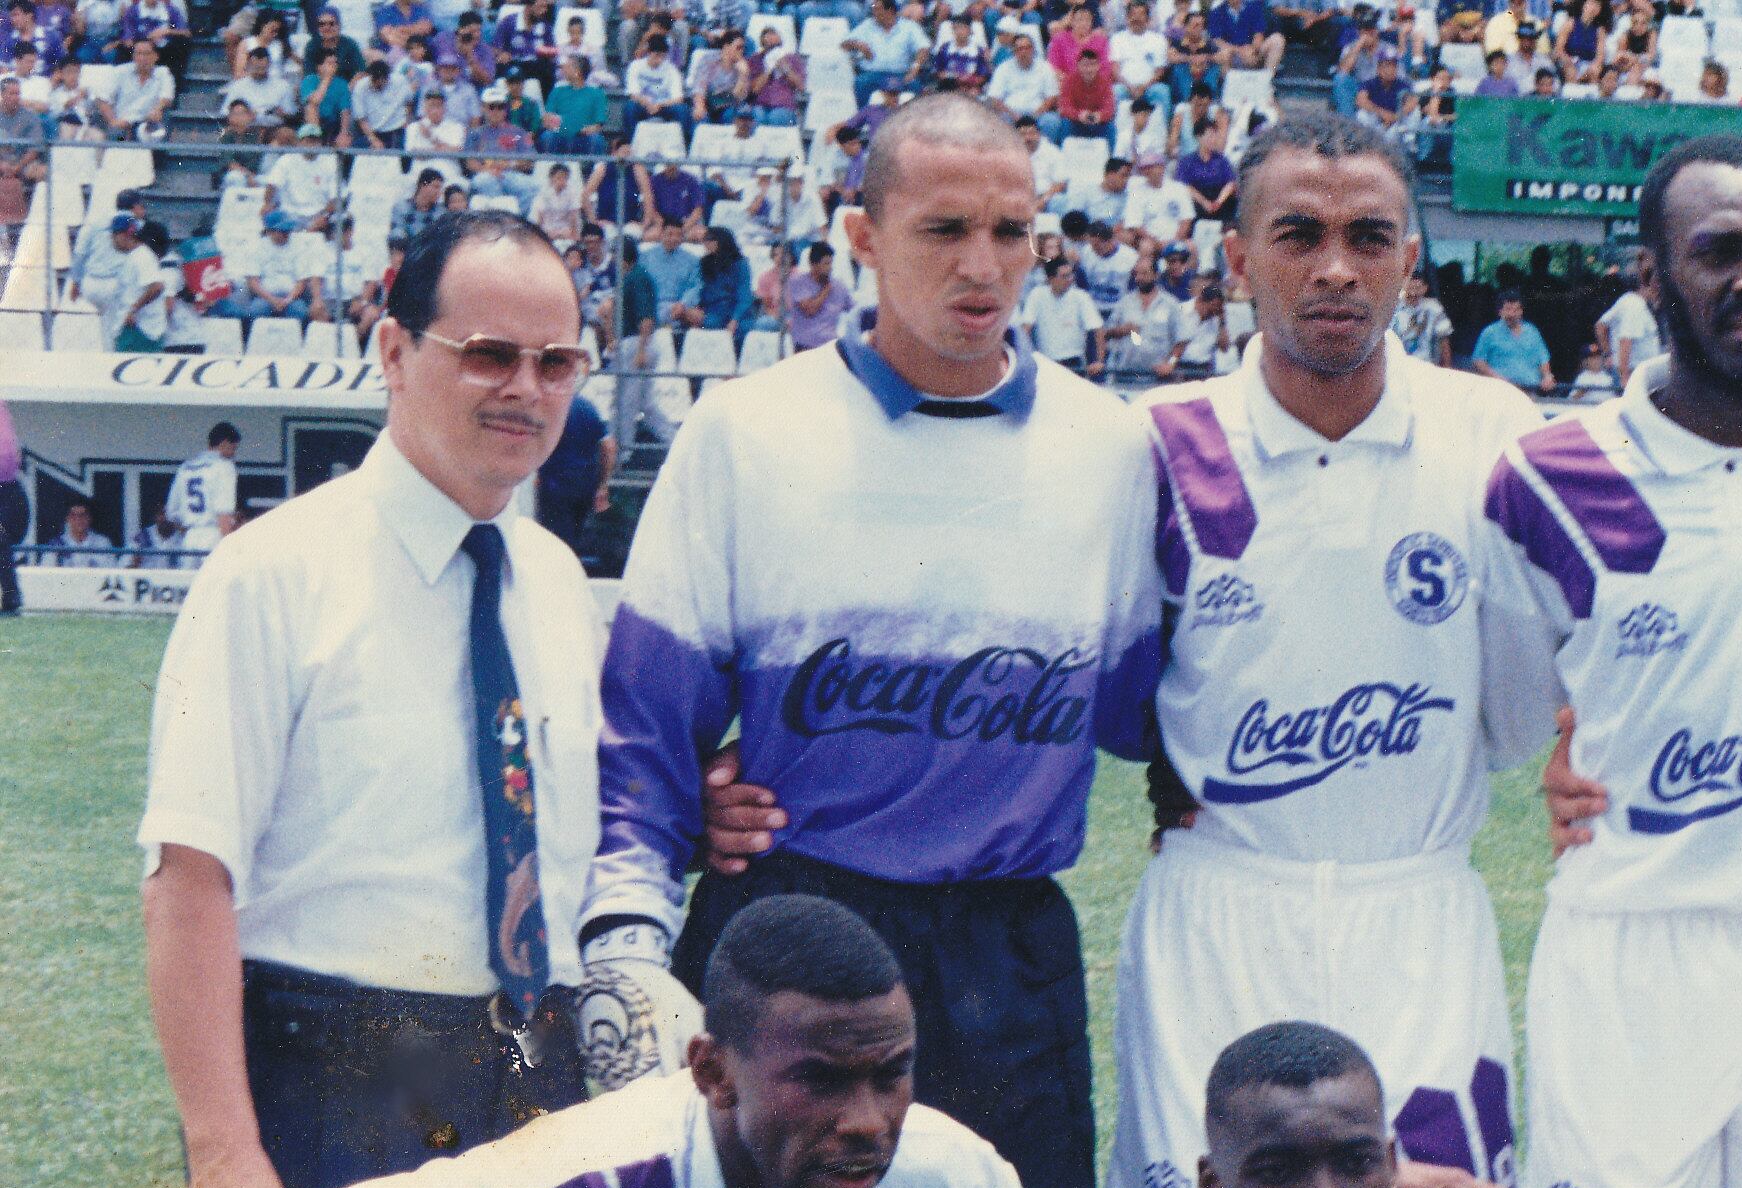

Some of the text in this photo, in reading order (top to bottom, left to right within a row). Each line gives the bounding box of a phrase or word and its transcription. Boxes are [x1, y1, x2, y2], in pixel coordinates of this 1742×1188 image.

[187, 477, 206, 514] 5
[1408, 551, 1445, 606] S
[782, 637, 1097, 746] Coca-Cola
[1225, 681, 1455, 776] Coca-Cola
